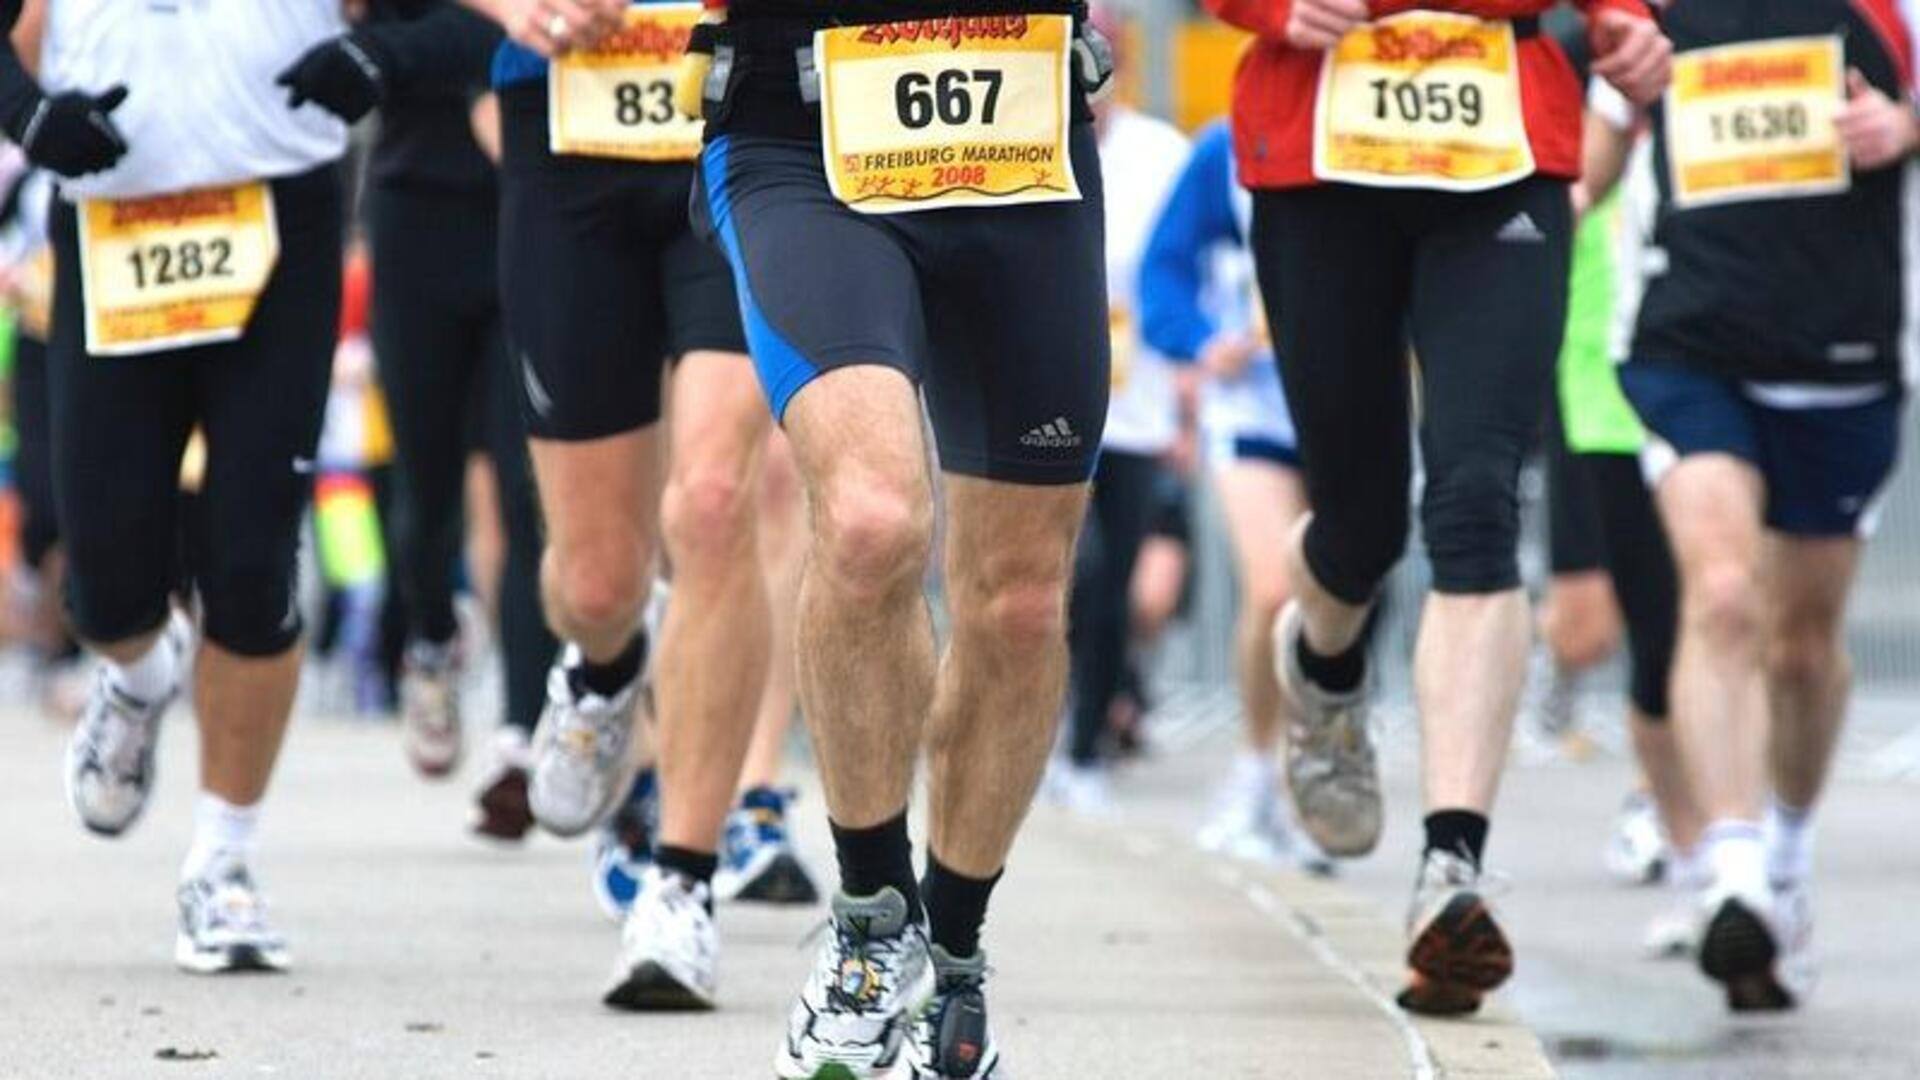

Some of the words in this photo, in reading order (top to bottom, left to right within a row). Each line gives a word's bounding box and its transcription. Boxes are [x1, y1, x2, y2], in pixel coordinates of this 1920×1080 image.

[614, 80, 699, 126] 83
[895, 69, 1003, 130] 667
[1369, 77, 1483, 127] 1059
[864, 147, 956, 171] FREIBURG
[961, 146, 1055, 164] MARATHON
[932, 165, 987, 188] 2008
[127, 236, 236, 290] 1282
